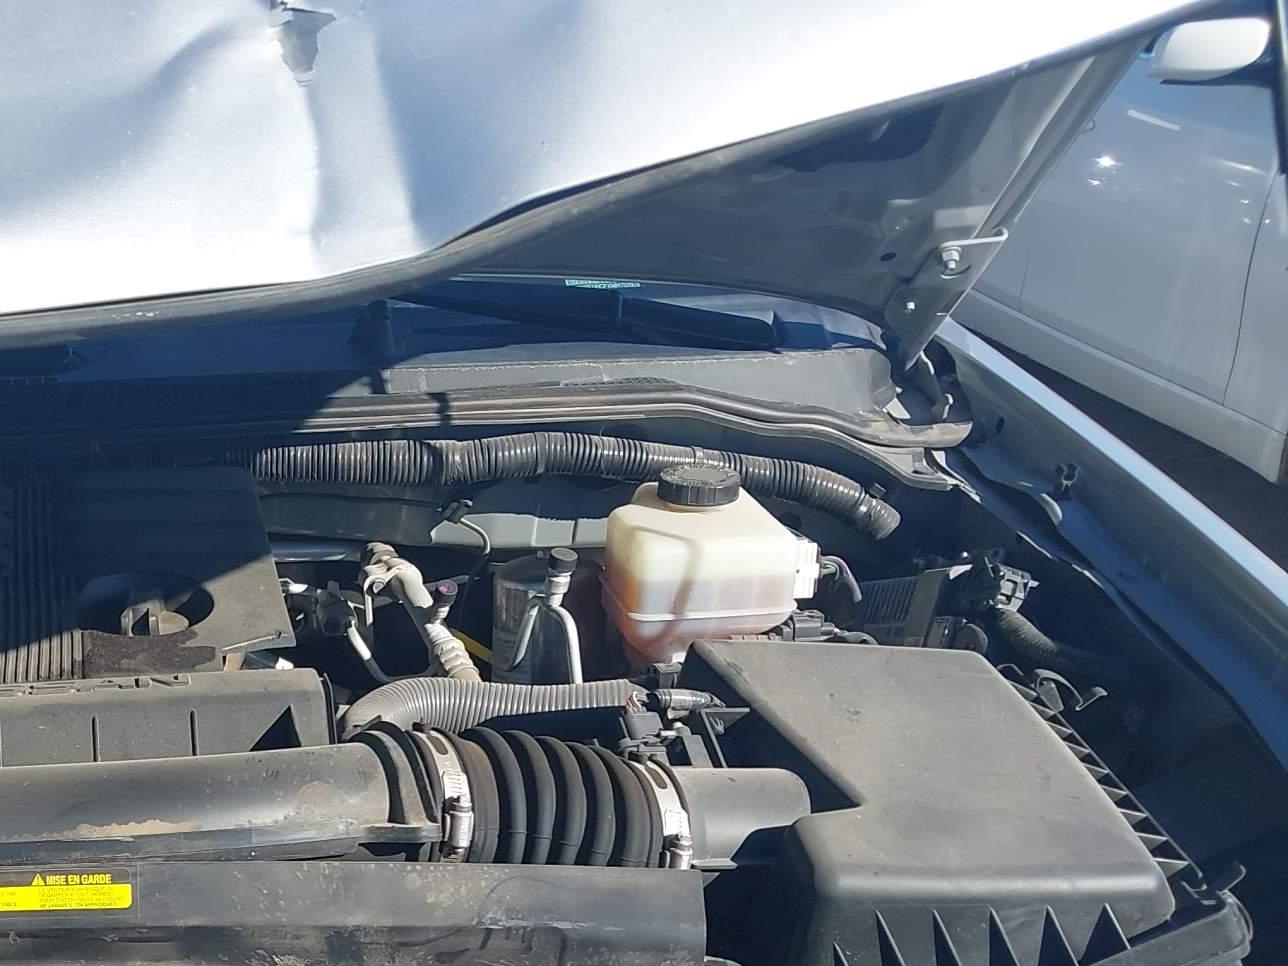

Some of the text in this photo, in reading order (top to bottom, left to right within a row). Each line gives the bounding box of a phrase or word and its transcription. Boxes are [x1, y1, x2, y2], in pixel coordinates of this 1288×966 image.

[46, 873, 112, 885] MISE EN GARDE
